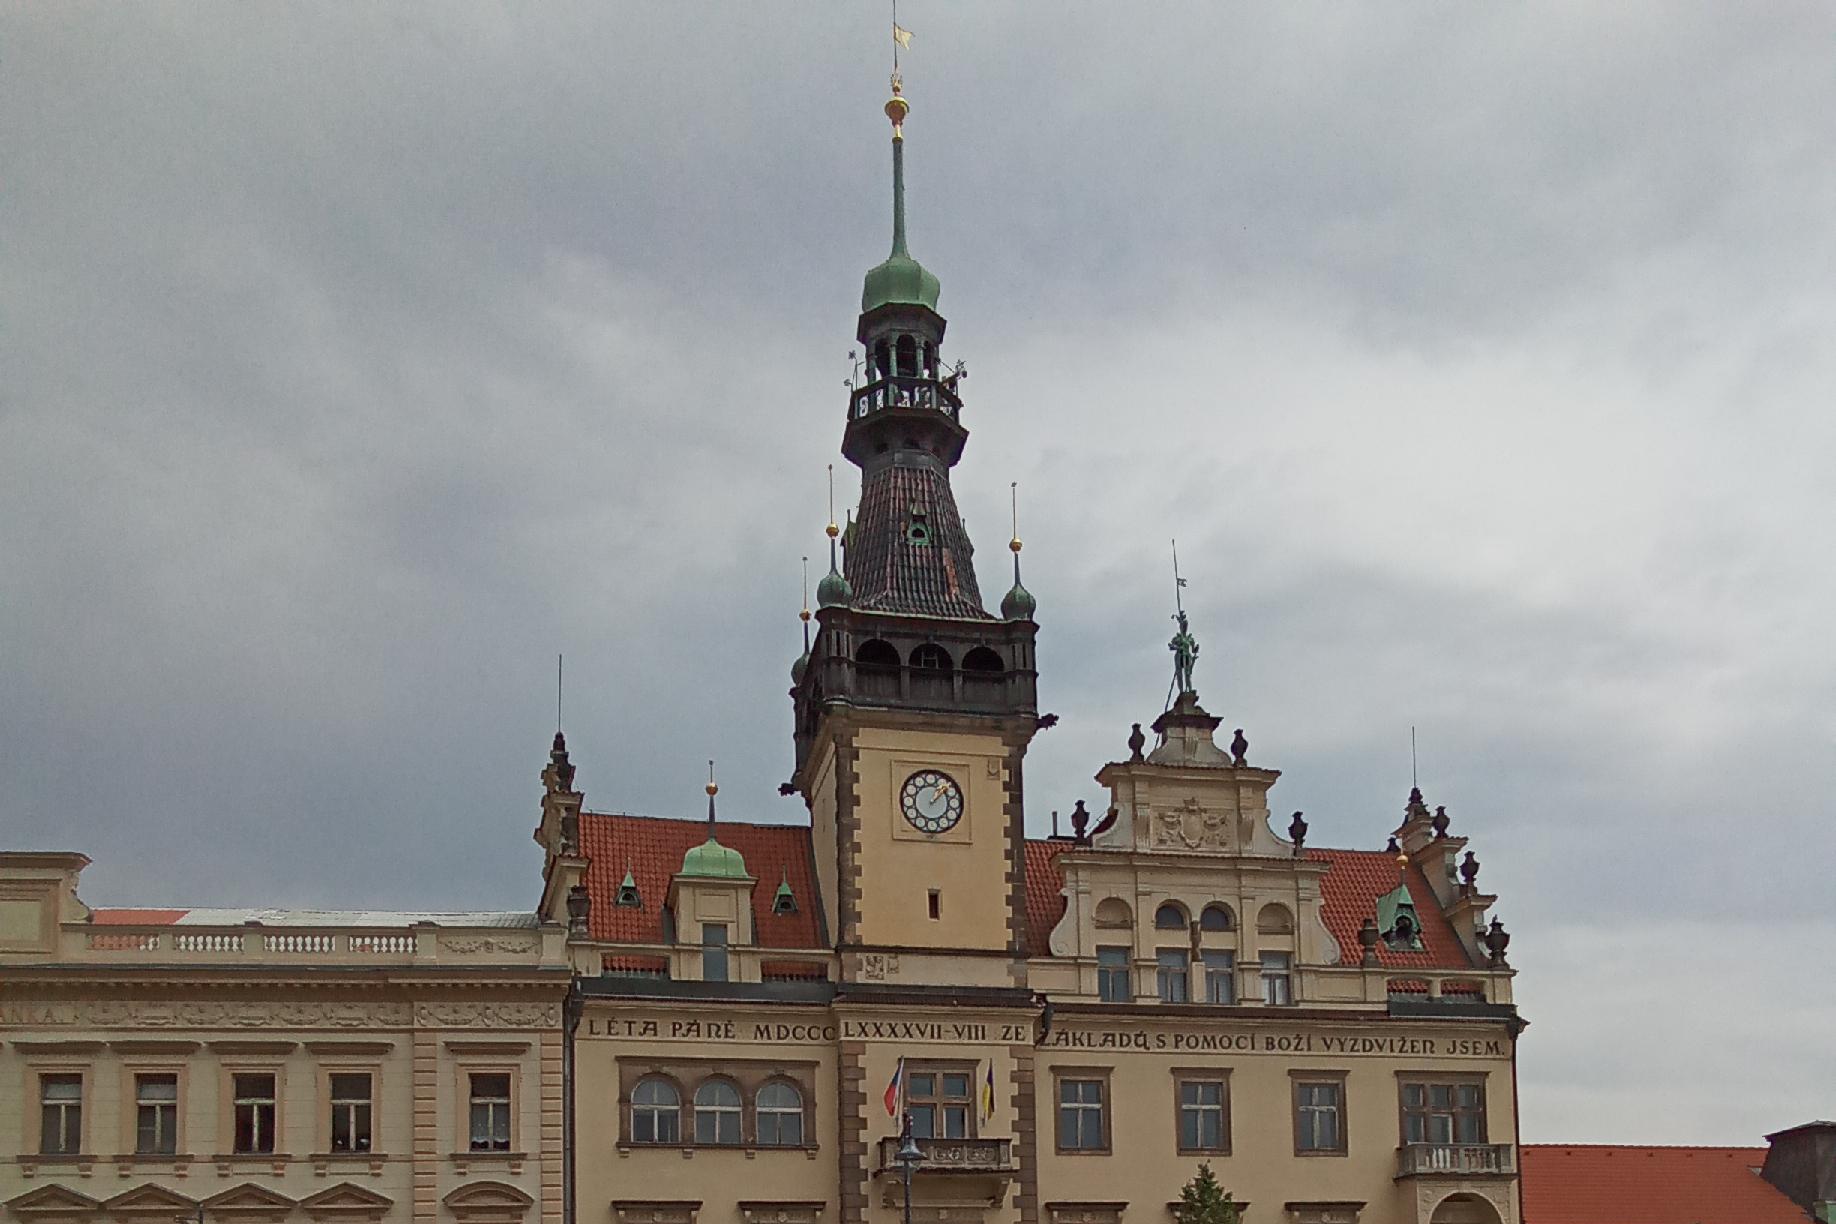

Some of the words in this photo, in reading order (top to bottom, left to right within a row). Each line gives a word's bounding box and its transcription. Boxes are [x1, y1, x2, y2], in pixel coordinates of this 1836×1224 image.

[589, 1016, 658, 1037] LÉTA
[1001, 1024, 1025, 1042] ZE
[1156, 1033, 1166, 1049] S
[1173, 1033, 1255, 1050] POMOCÍ
[1265, 1033, 1312, 1051] BOŽÍ
[1321, 1036, 1434, 1054] VYZDVIŽEN
[1446, 1040, 1505, 1056] JSEM.
